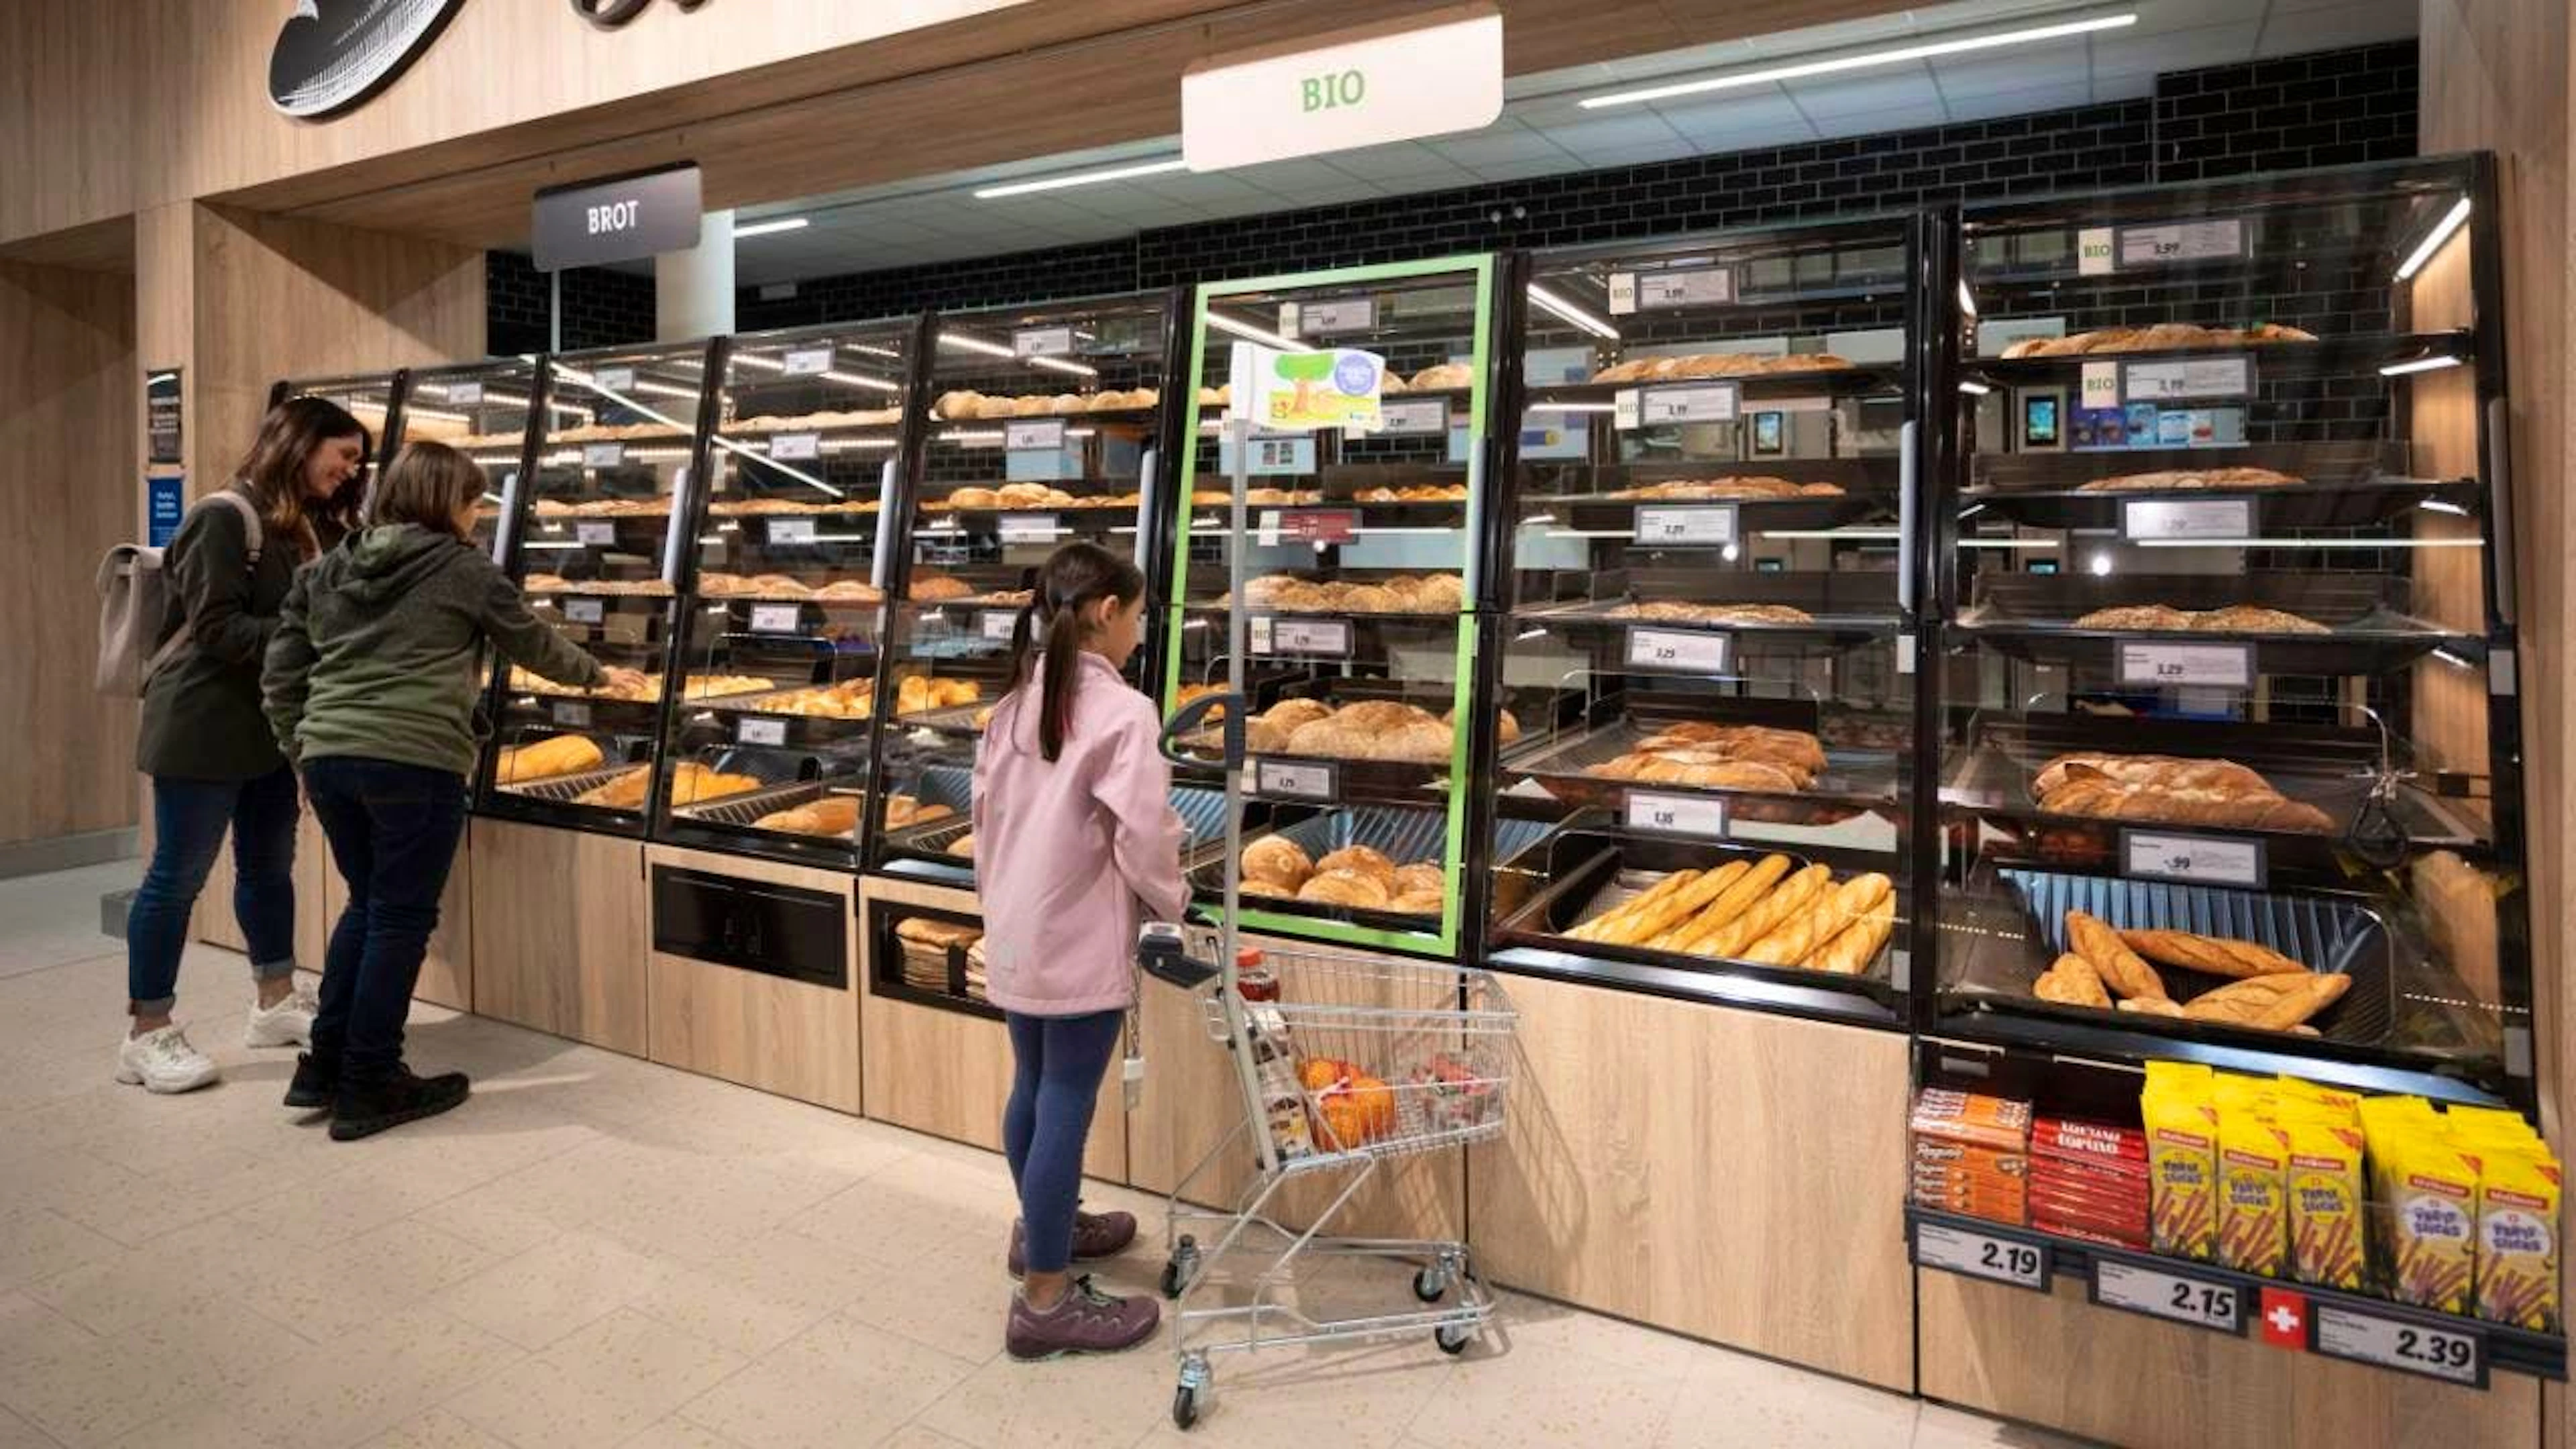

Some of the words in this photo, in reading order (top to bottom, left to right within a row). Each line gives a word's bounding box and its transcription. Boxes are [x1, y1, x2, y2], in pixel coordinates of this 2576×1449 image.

[1301, 70, 1364, 112] BIO
[588, 201, 639, 234] BROT
[2084, 244, 2110, 258] BIO
[2086, 378, 2114, 392] BIO
[1981, 1242, 2037, 1275] 2.19
[2171, 1282, 2235, 1317] 2.15
[2396, 1329, 2471, 1367] 2.39
